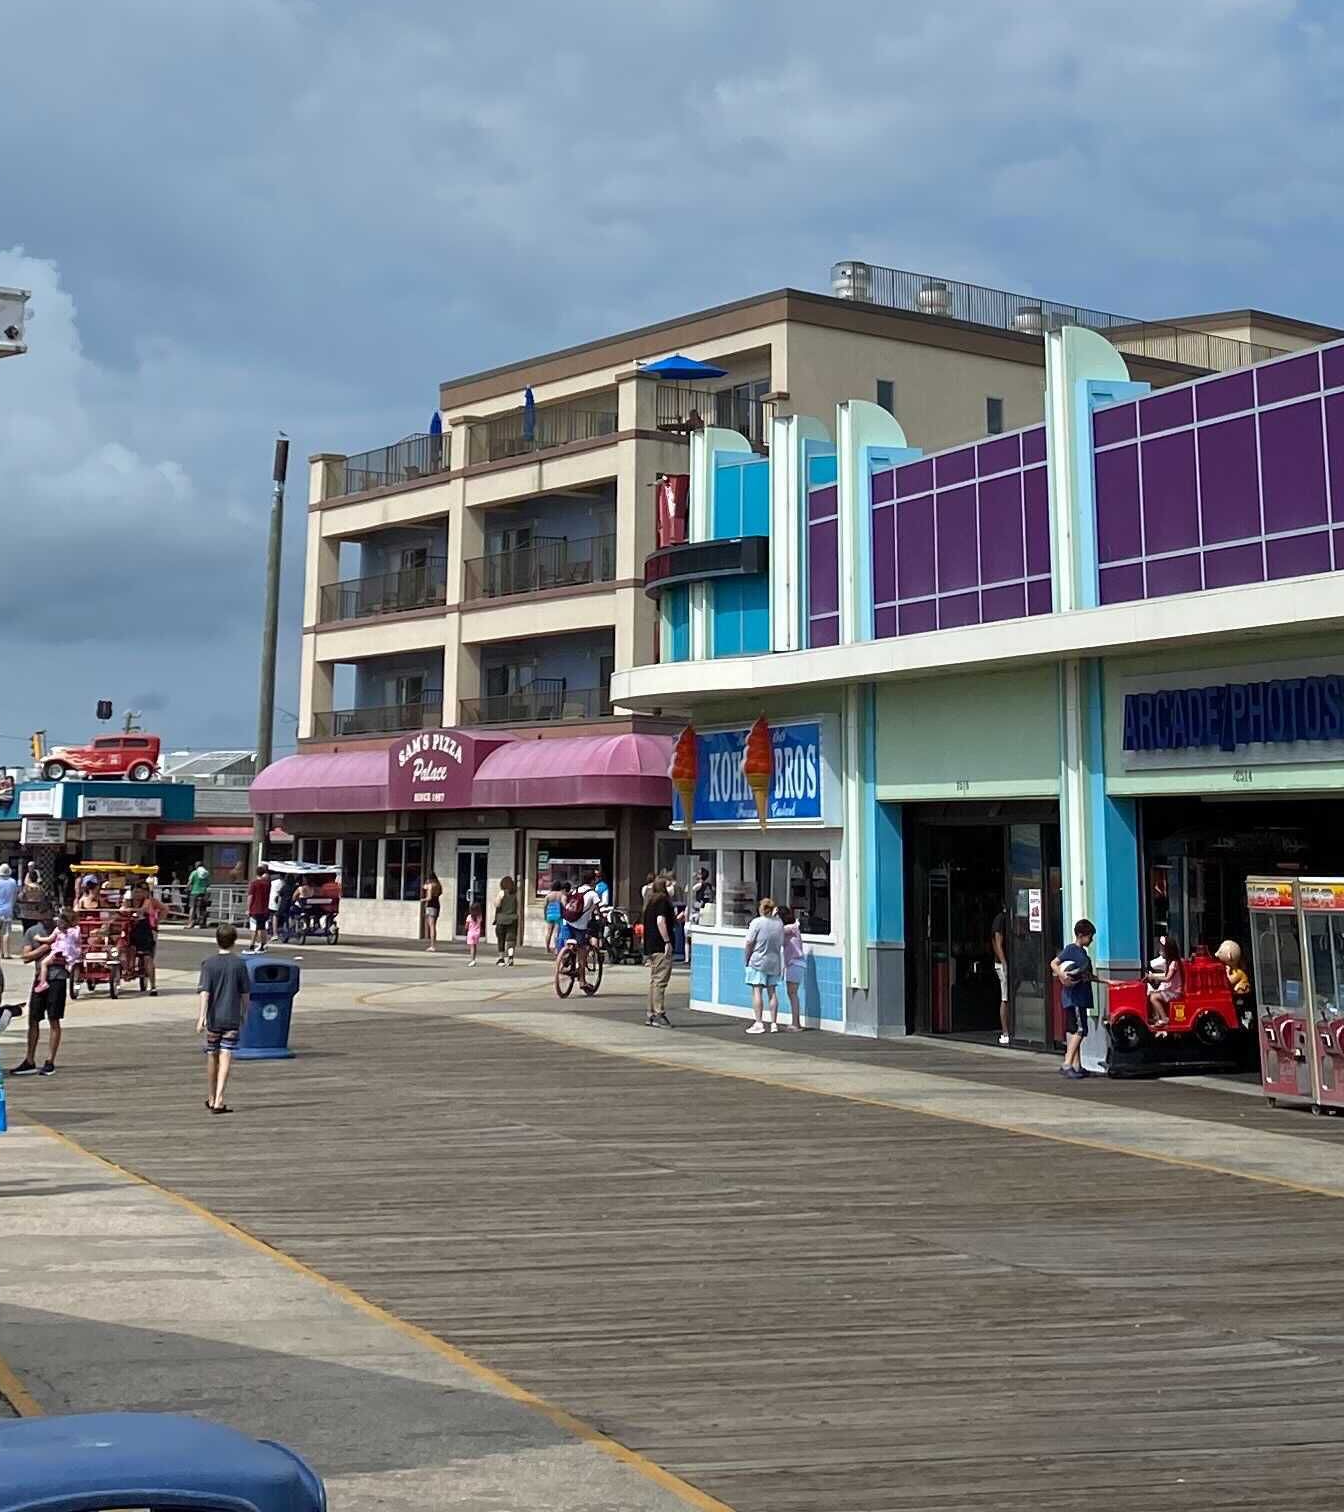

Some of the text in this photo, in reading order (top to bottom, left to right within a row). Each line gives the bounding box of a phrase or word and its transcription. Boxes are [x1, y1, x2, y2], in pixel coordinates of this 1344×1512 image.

[432, 734, 463, 764] PIZZA
[412, 758, 448, 783] Palace
[774, 744, 817, 800] BROS
